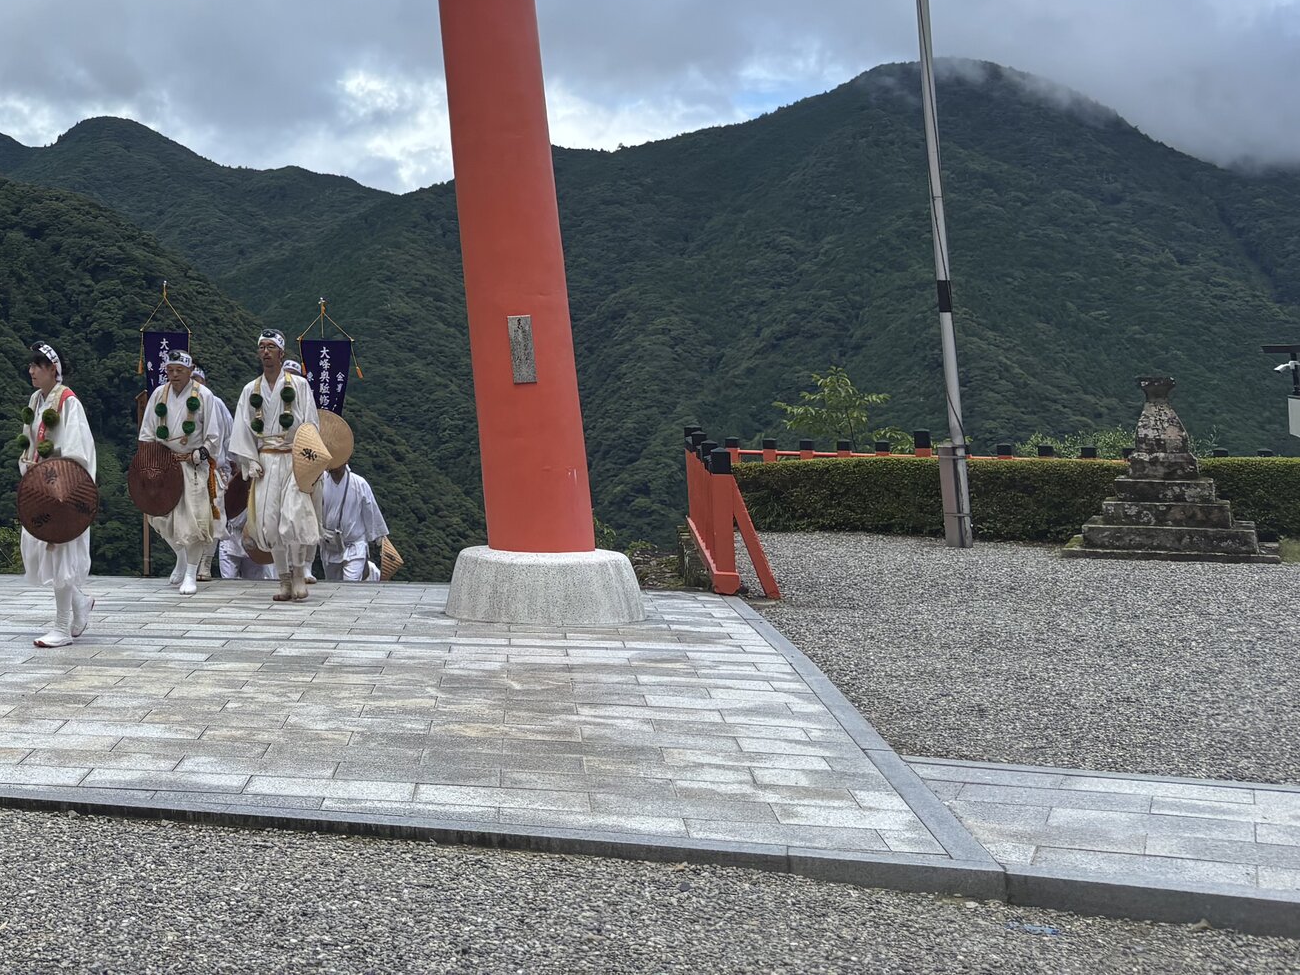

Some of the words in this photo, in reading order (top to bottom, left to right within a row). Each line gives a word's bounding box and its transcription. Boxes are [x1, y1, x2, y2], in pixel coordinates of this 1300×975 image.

[319, 346, 331, 409] 大峰奥駈修
